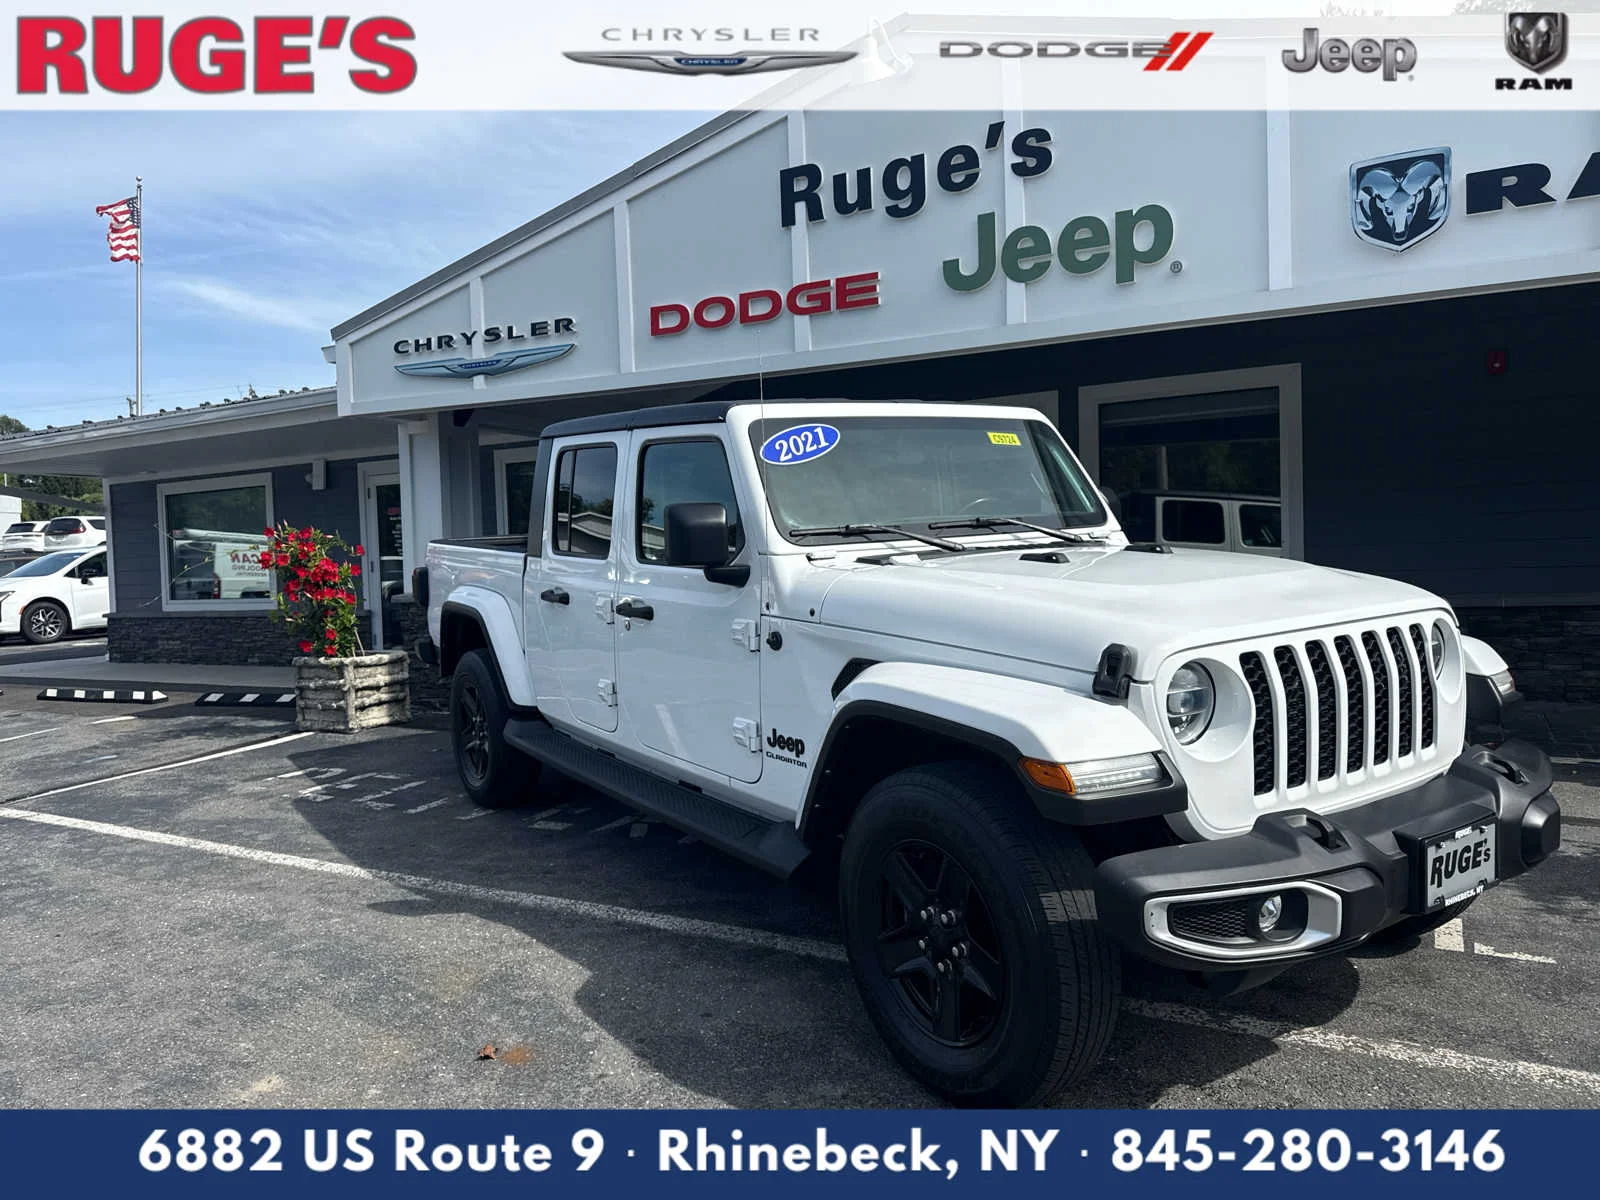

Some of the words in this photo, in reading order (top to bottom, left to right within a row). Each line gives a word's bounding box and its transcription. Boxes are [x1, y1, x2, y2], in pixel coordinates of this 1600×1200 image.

[779, 121, 1054, 228] Ruge's
[942, 204, 1174, 292] Jeep
[650, 271, 881, 337] DODGE
[393, 317, 577, 355] CHRYSLER
[775, 426, 829, 462] 2021
[765, 751, 808, 769] GLADIATOR
[766, 727, 806, 759] Jeep
